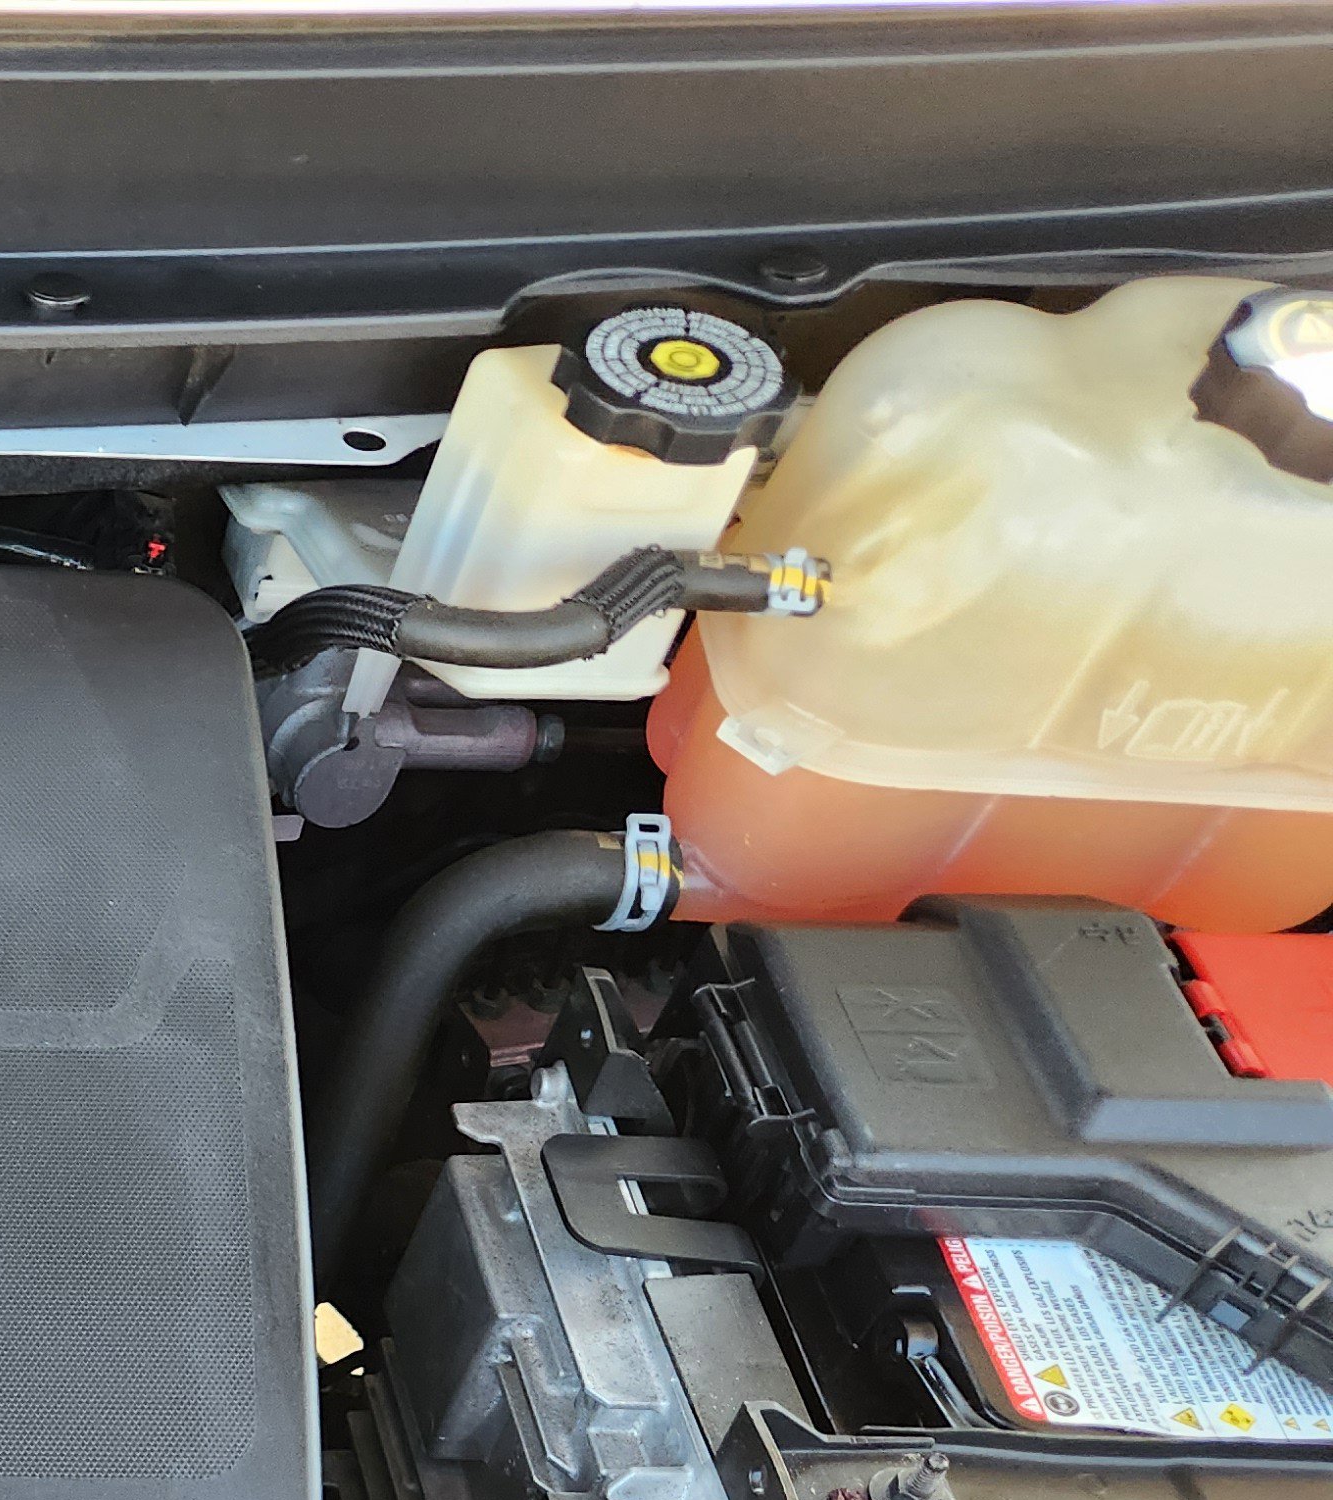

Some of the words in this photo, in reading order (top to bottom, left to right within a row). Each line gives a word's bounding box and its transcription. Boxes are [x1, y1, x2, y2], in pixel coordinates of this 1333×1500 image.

[942, 1237, 978, 1273] PELIG
[1010, 1249, 1040, 1290] EXPLOSIFS
[979, 1266, 1007, 1307] EXPLOSIVE
[1031, 1292, 1048, 1308] GAZ
[1040, 1310, 1056, 1325] LES
[1061, 1297, 1083, 1324] GASES
[969, 1294, 1033, 1395] DANGER/POISON
[1023, 1334, 1045, 1360] GASES
[1075, 1326, 1092, 1341] LOS
[1059, 1350, 1076, 1365] LES
[1128, 1344, 1147, 1362] ACID
[1112, 1372, 1147, 1422] EXPLOSIVOS
[1139, 1365, 1169, 1403] SULFURIC
